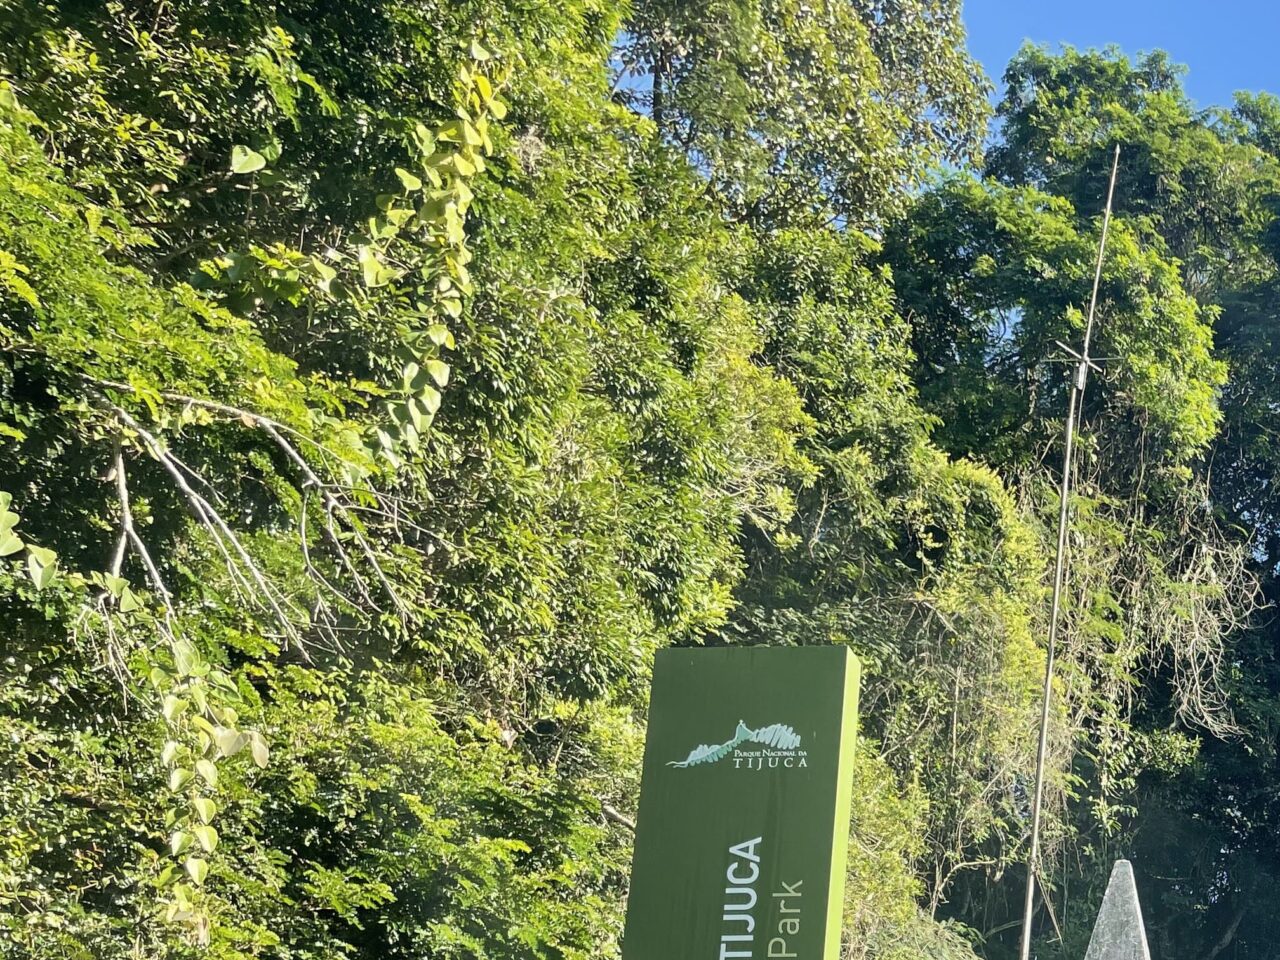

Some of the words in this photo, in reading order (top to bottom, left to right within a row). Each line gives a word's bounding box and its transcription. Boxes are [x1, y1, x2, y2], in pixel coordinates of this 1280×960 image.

[733, 748, 762, 758] PARQUE
[762, 748, 797, 758] NACIONAL
[798, 750, 808, 758] DA
[732, 757, 808, 771] TIJUCA
[768, 879, 804, 958] Park
